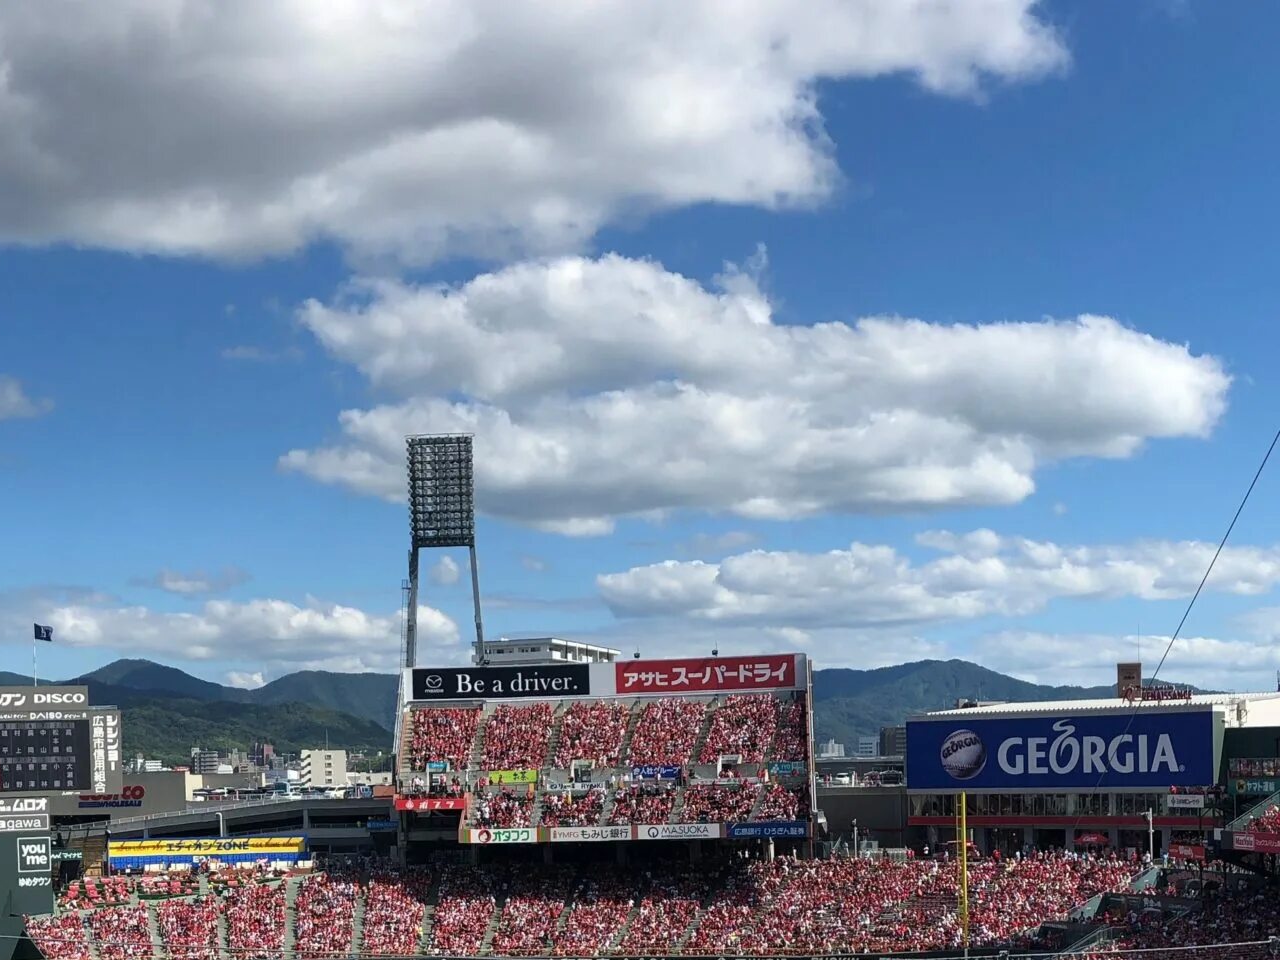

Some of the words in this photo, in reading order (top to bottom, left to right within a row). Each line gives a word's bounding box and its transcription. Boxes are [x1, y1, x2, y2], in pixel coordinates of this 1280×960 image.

[456, 674, 485, 693] Be
[492, 681, 503, 692] a
[510, 672, 578, 692] driver.
[33, 693, 85, 704] DISCO
[942, 737, 980, 759] GEORGIA
[997, 719, 1180, 775] GEORGIA
[92, 715, 106, 793] 広島市信用組合
[1246, 782, 1275, 792] ヤマト運輸
[12, 798, 47, 812] ムロオ
[493, 830, 530, 842] オタフク
[580, 827, 631, 840] もみじ銀行
[661, 826, 709, 834] MASUOKA
[734, 828, 761, 836] 広島銀行
[764, 827, 805, 835] ひろぎん証券
[21, 843, 46, 857] you
[166, 843, 213, 852] エディオン
[217, 842, 250, 851] ZONE
[26, 854, 47, 865] me
[18, 876, 51, 887] ゆめタウン
